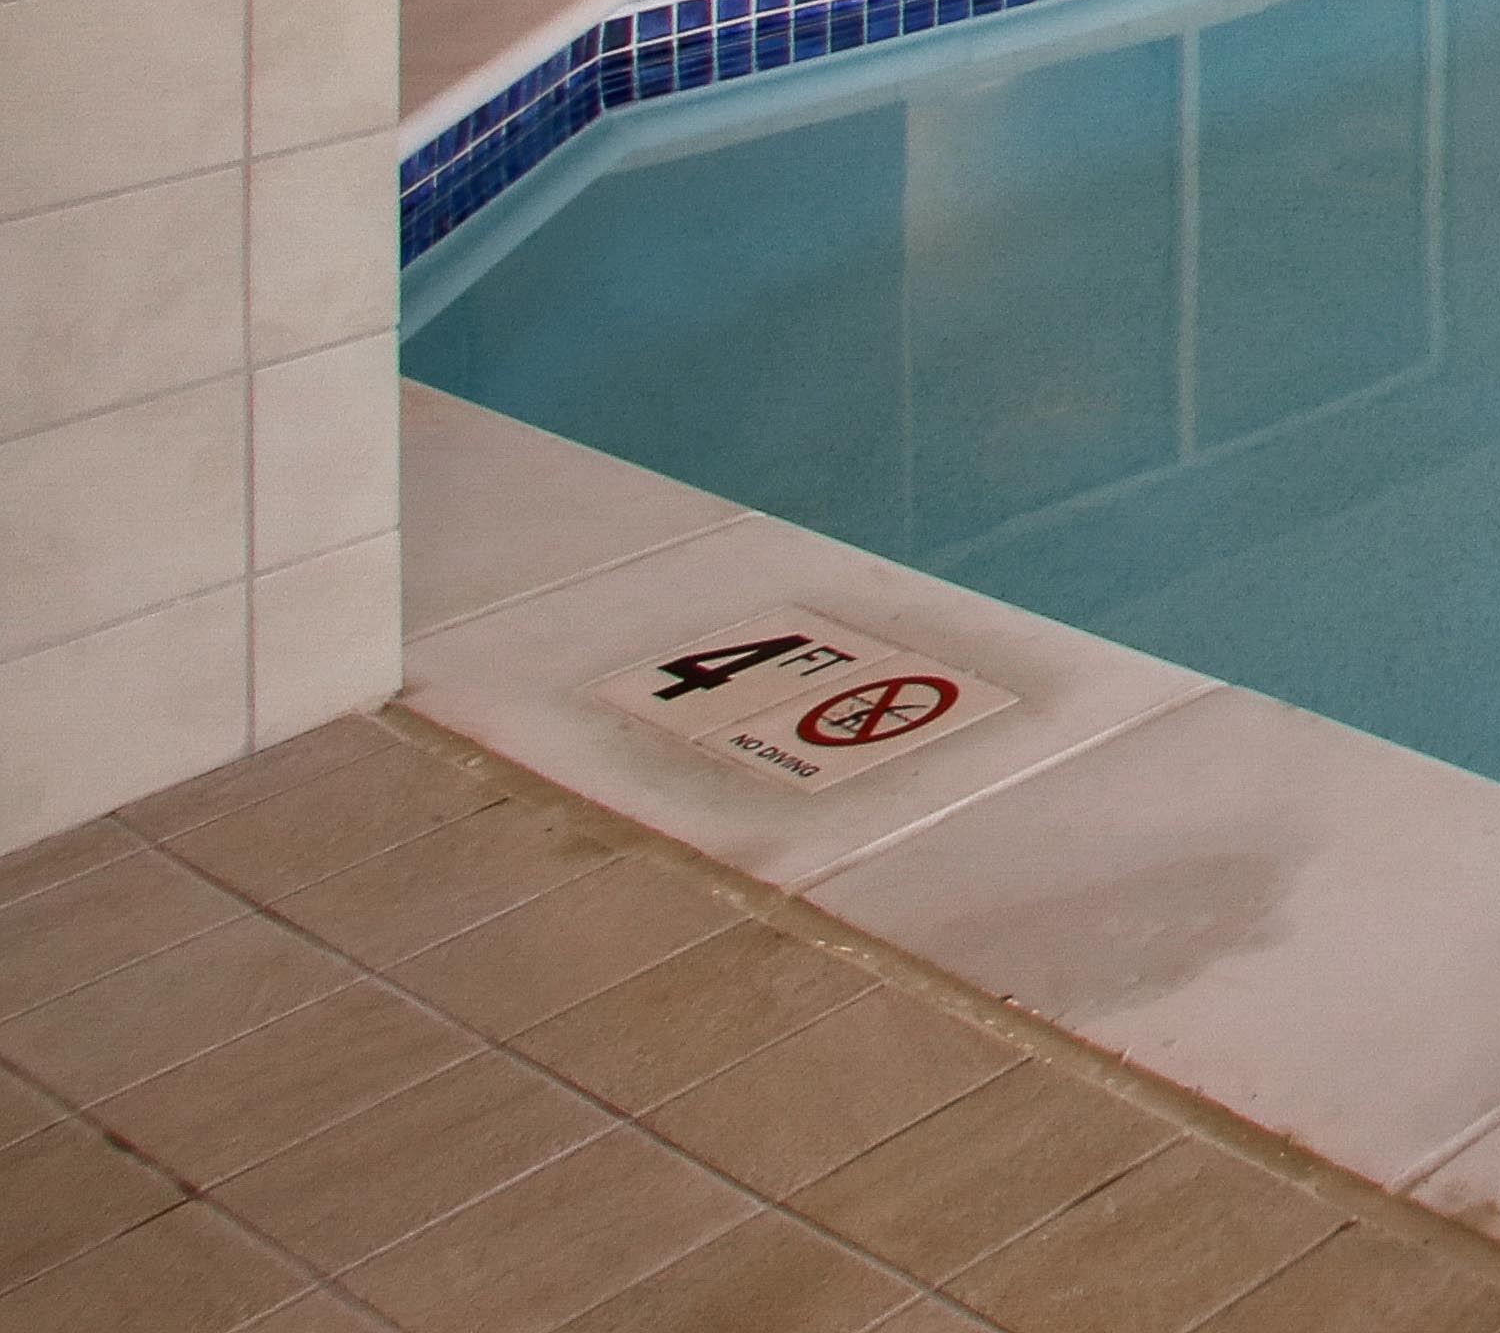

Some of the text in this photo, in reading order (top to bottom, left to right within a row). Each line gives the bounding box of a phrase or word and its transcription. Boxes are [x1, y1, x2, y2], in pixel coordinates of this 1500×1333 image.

[652, 634, 858, 700] 4 FT
[729, 733, 820, 778] NO DIVING
